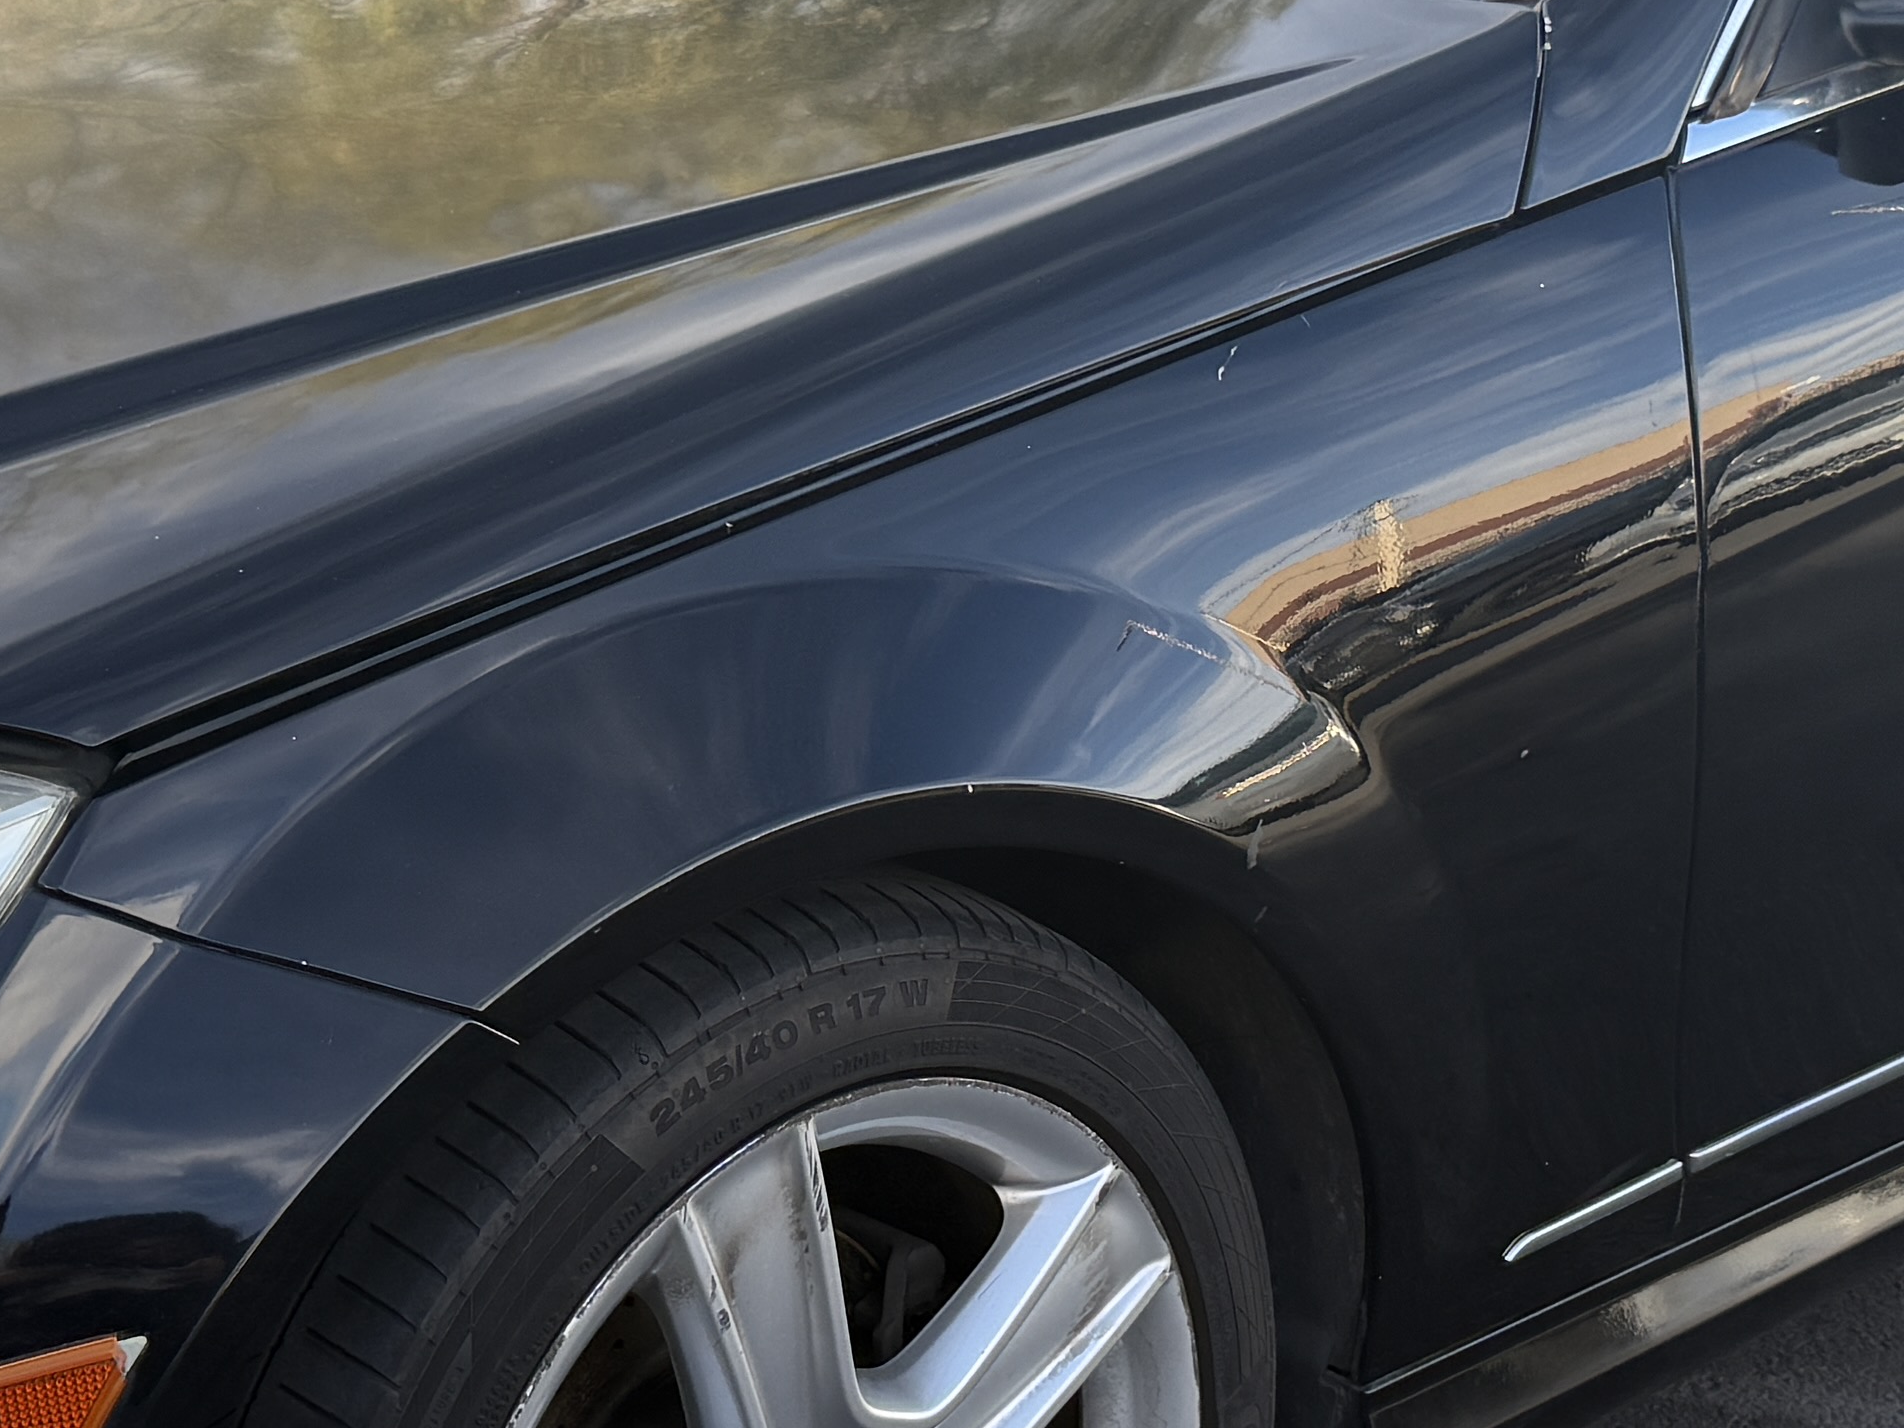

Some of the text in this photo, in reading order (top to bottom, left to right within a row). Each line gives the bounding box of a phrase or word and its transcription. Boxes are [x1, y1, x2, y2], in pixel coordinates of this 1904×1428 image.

[649, 977, 930, 1138] 245/40 R 17 W
